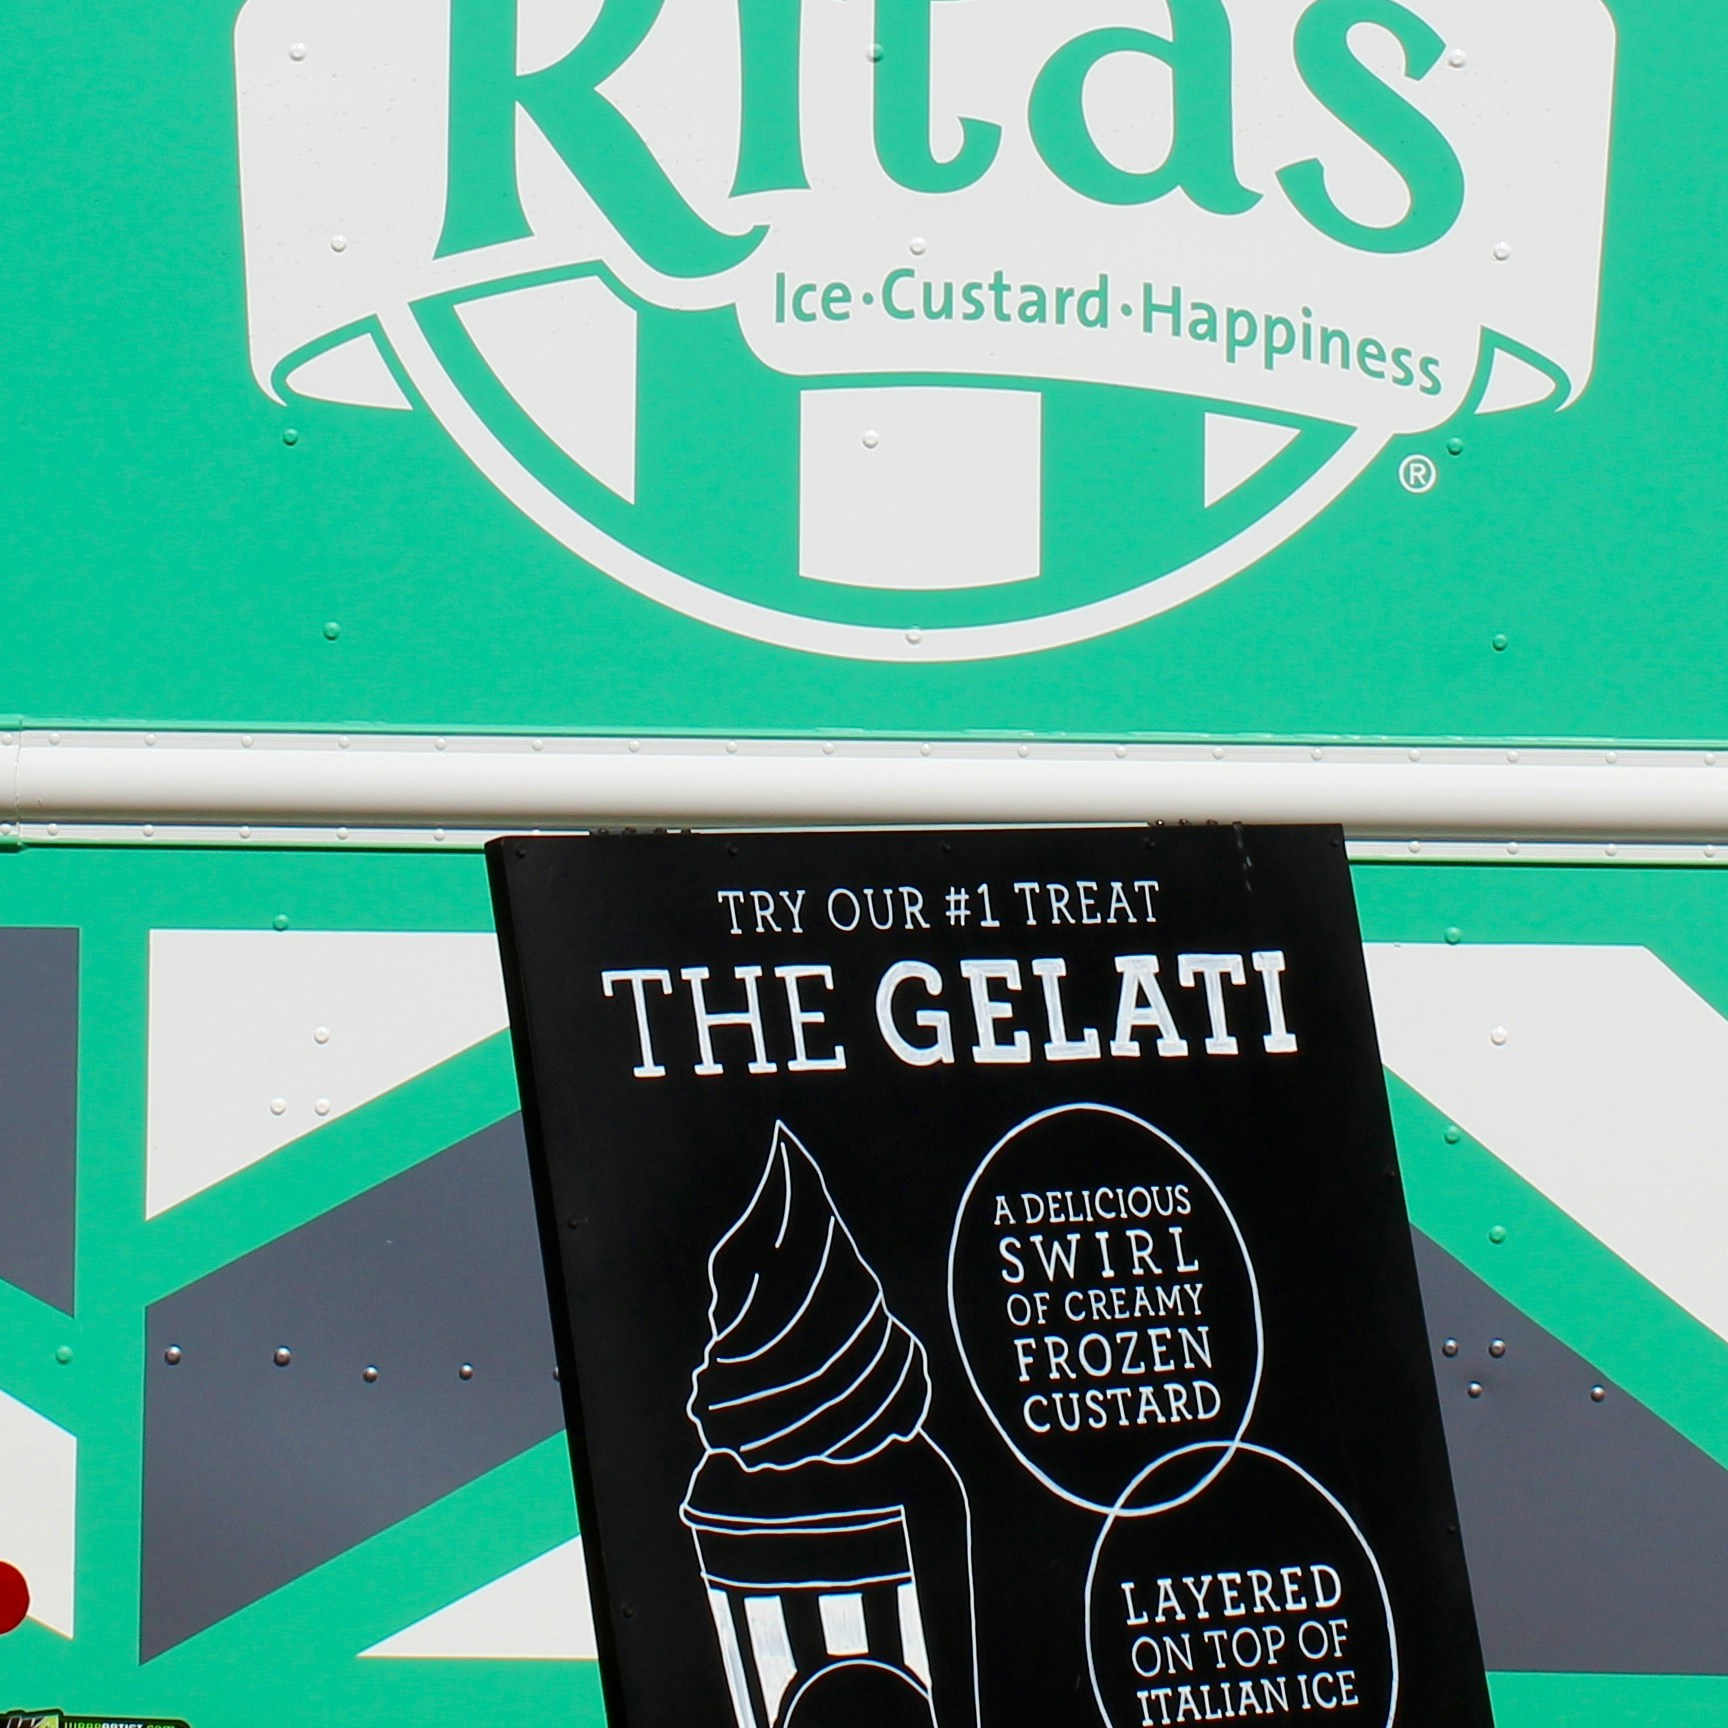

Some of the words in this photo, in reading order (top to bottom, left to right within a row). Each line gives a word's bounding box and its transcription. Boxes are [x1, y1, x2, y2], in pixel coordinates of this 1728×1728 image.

[717, 889, 806, 935] TRY
[827, 885, 931, 932] OUR
[944, 882, 1001, 928] #1
[1013, 879, 1160, 926] TREAT
[601, 964, 847, 1078] THE
[875, 950, 1298, 1066] GELATI
[993, 1194, 1017, 1226] A
[1020, 1183, 1192, 1224] DELICIOUS
[998, 1226, 1200, 1284] SWIRL
[1006, 1291, 1051, 1327] OF
[1064, 1283, 1204, 1322] CREAMY
[1013, 1325, 1213, 1382] FROZEN
[1023, 1379, 1222, 1434] CUSTARD
[1121, 1563, 1342, 1626] LAYERED
[1131, 1632, 1194, 1678] ON
[1203, 1624, 1286, 1669] TOP
[1297, 1618, 1348, 1660] OF
[1136, 1676, 1289, 1727] ITALIAN
[1297, 1669, 1359, 1710] ICE
